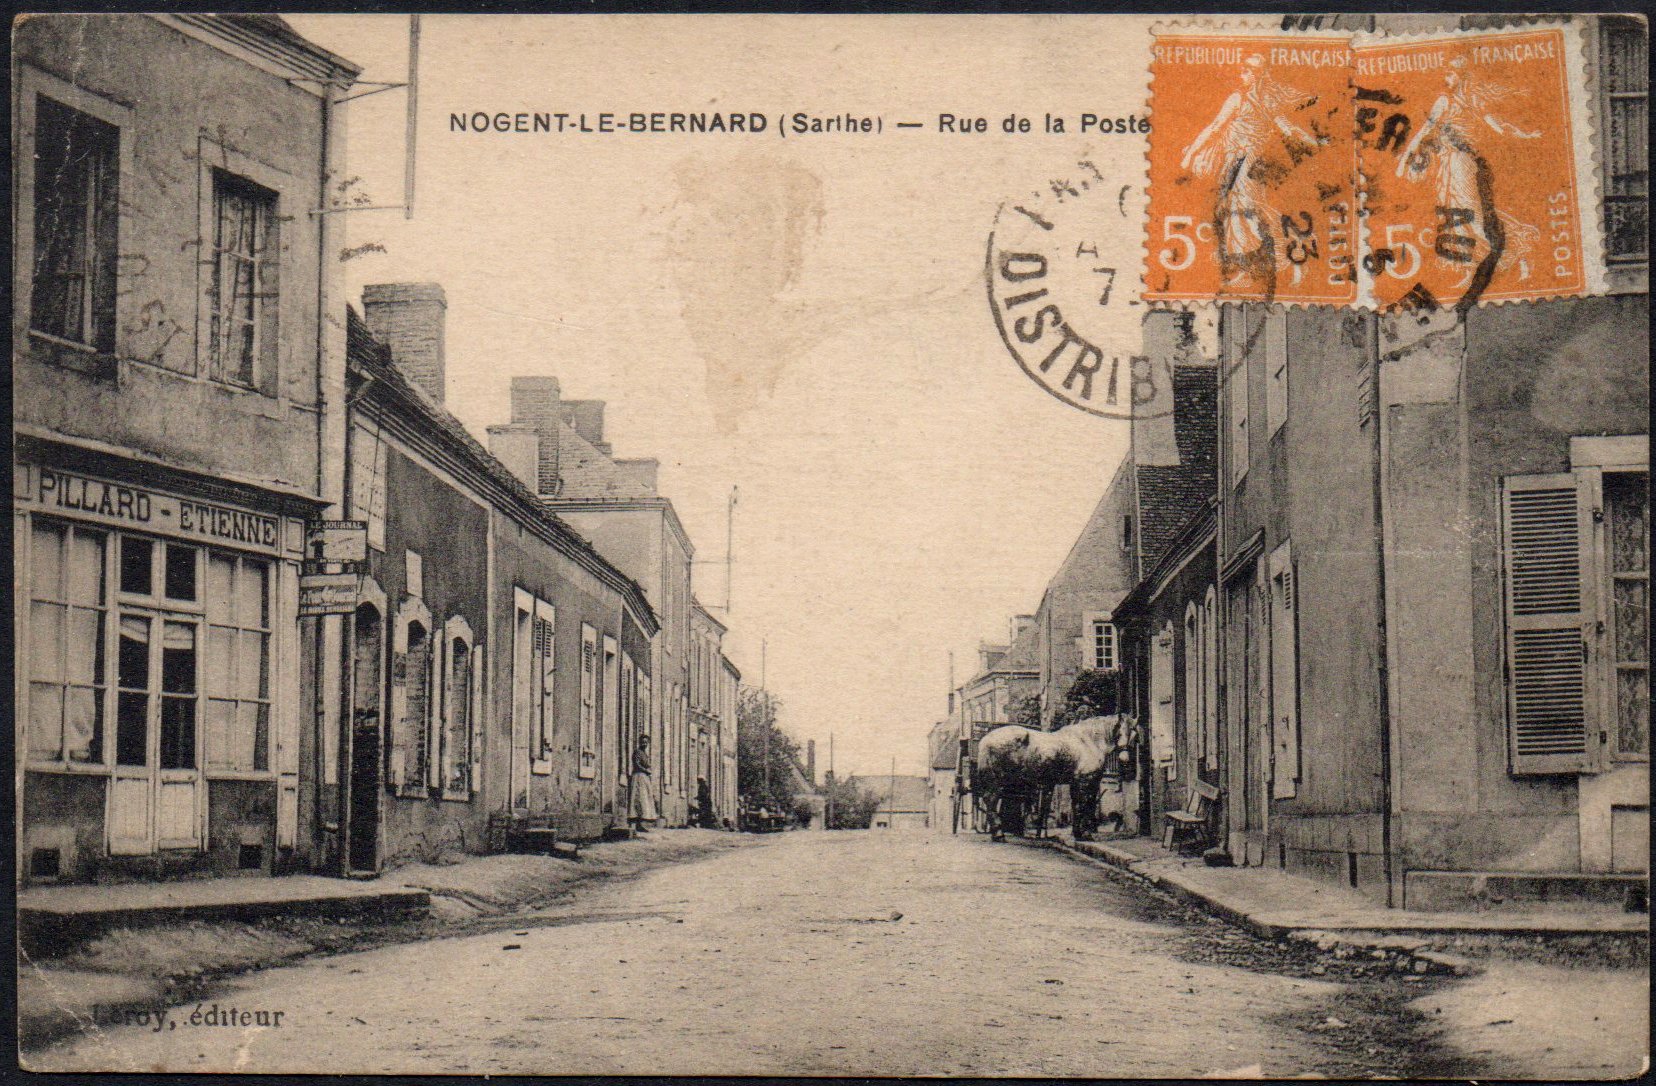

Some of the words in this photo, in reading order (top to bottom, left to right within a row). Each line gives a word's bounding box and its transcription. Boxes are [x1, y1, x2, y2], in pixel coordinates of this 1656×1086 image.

[1548, 191, 1573, 277] POSTES
[39, 469, 151, 522] PILLARD
[179, 501, 277, 547] ETIENNE
[323, 521, 363, 530] JOURNAL
